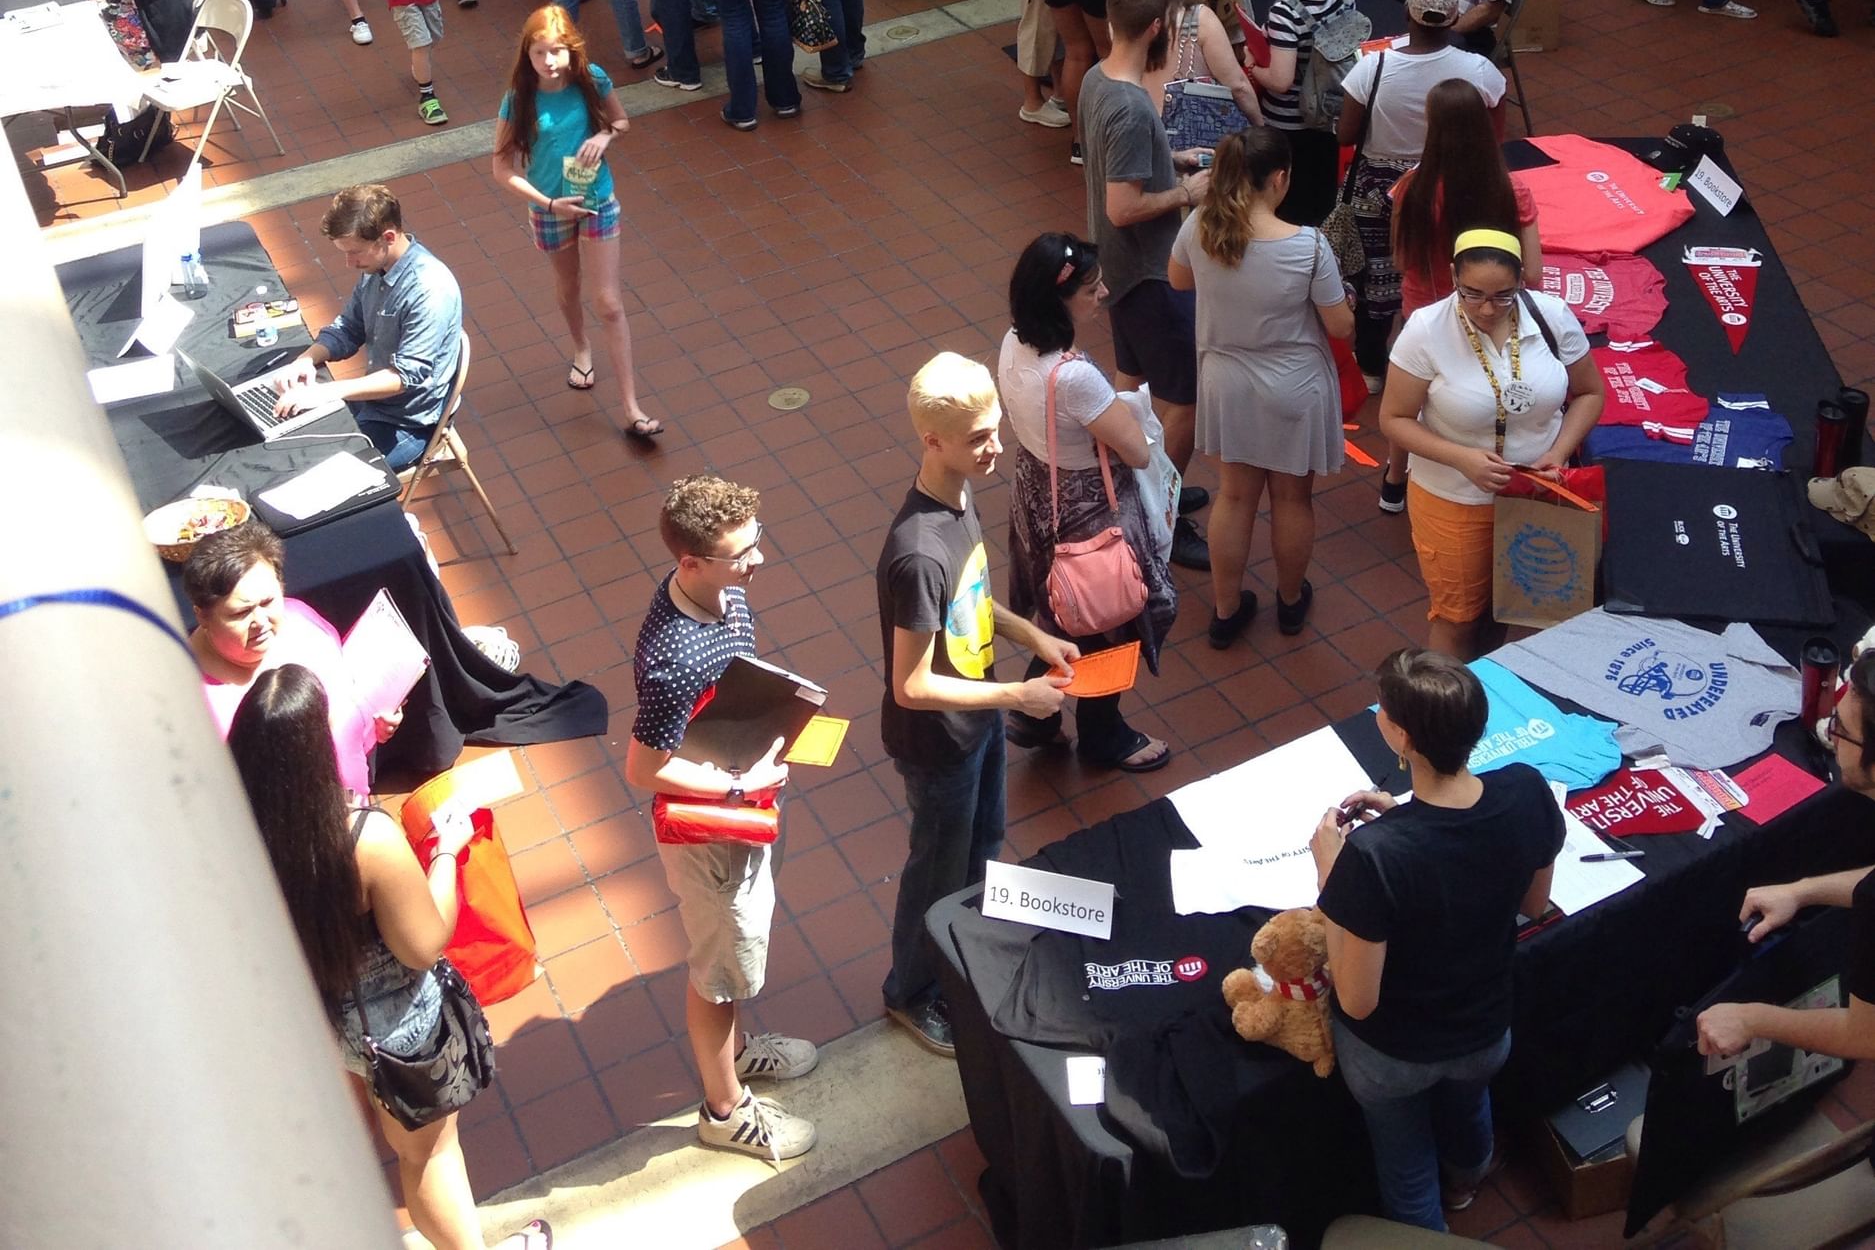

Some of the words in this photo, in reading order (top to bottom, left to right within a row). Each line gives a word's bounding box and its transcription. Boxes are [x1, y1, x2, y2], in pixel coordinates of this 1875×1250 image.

[1703, 176, 1733, 209] Bookstore
[1698, 272, 1713, 283] OF
[1726, 269, 1742, 281] THE
[1705, 281, 1722, 296] THE
[1708, 266, 1749, 308] UNIVERSITY
[1712, 295, 1735, 312] ARTS
[1730, 533, 1746, 569] UNIVERSITY
[1619, 637, 1657, 658] Since
[1604, 658, 1626, 682] 1876
[1663, 662, 1729, 721] UNDEFEATED
[1466, 740, 1519, 770] UNIVERSI
[1598, 785, 1634, 809] THE
[1569, 799, 1601, 821] ART
[1591, 786, 1677, 830] UNIVERSIT
[1652, 802, 1684, 818] THE
[989, 886, 1014, 906] 19.
[1020, 891, 1105, 923] Bookstore
[1086, 964, 1120, 978] ARTS
[1123, 961, 1150, 973] THE
[1153, 963, 1171, 973] OF
[1088, 973, 1151, 989] UNIVERSITY
[1152, 973, 1173, 984] THE
